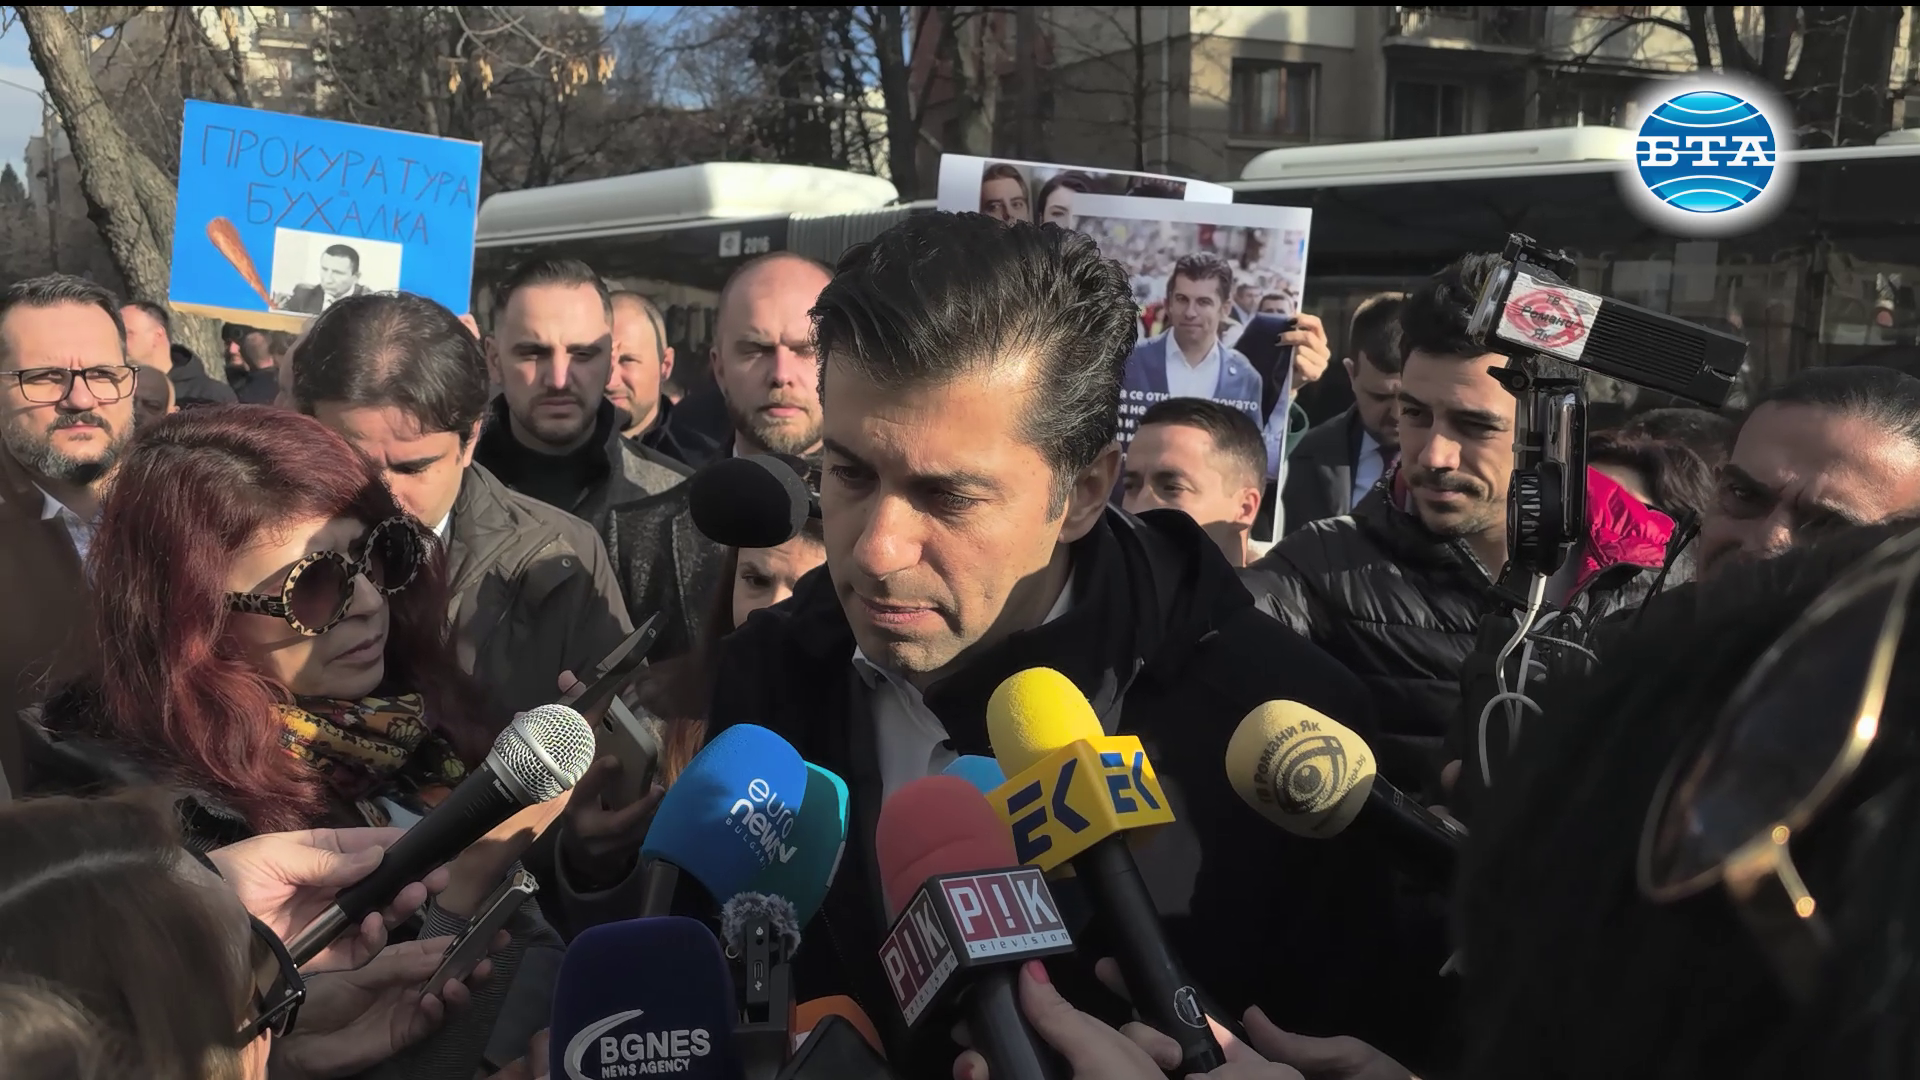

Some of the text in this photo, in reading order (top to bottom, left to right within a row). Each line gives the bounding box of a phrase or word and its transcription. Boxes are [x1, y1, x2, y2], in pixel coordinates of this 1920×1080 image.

[201, 124, 472, 209] ПРОКУРАТУРА
[246, 182, 429, 245] БУХАЛКА
[748, 778, 794, 839] euro
[600, 1028, 711, 1064] BGNES
[601, 1058, 691, 1079] NEWS AGENCY
